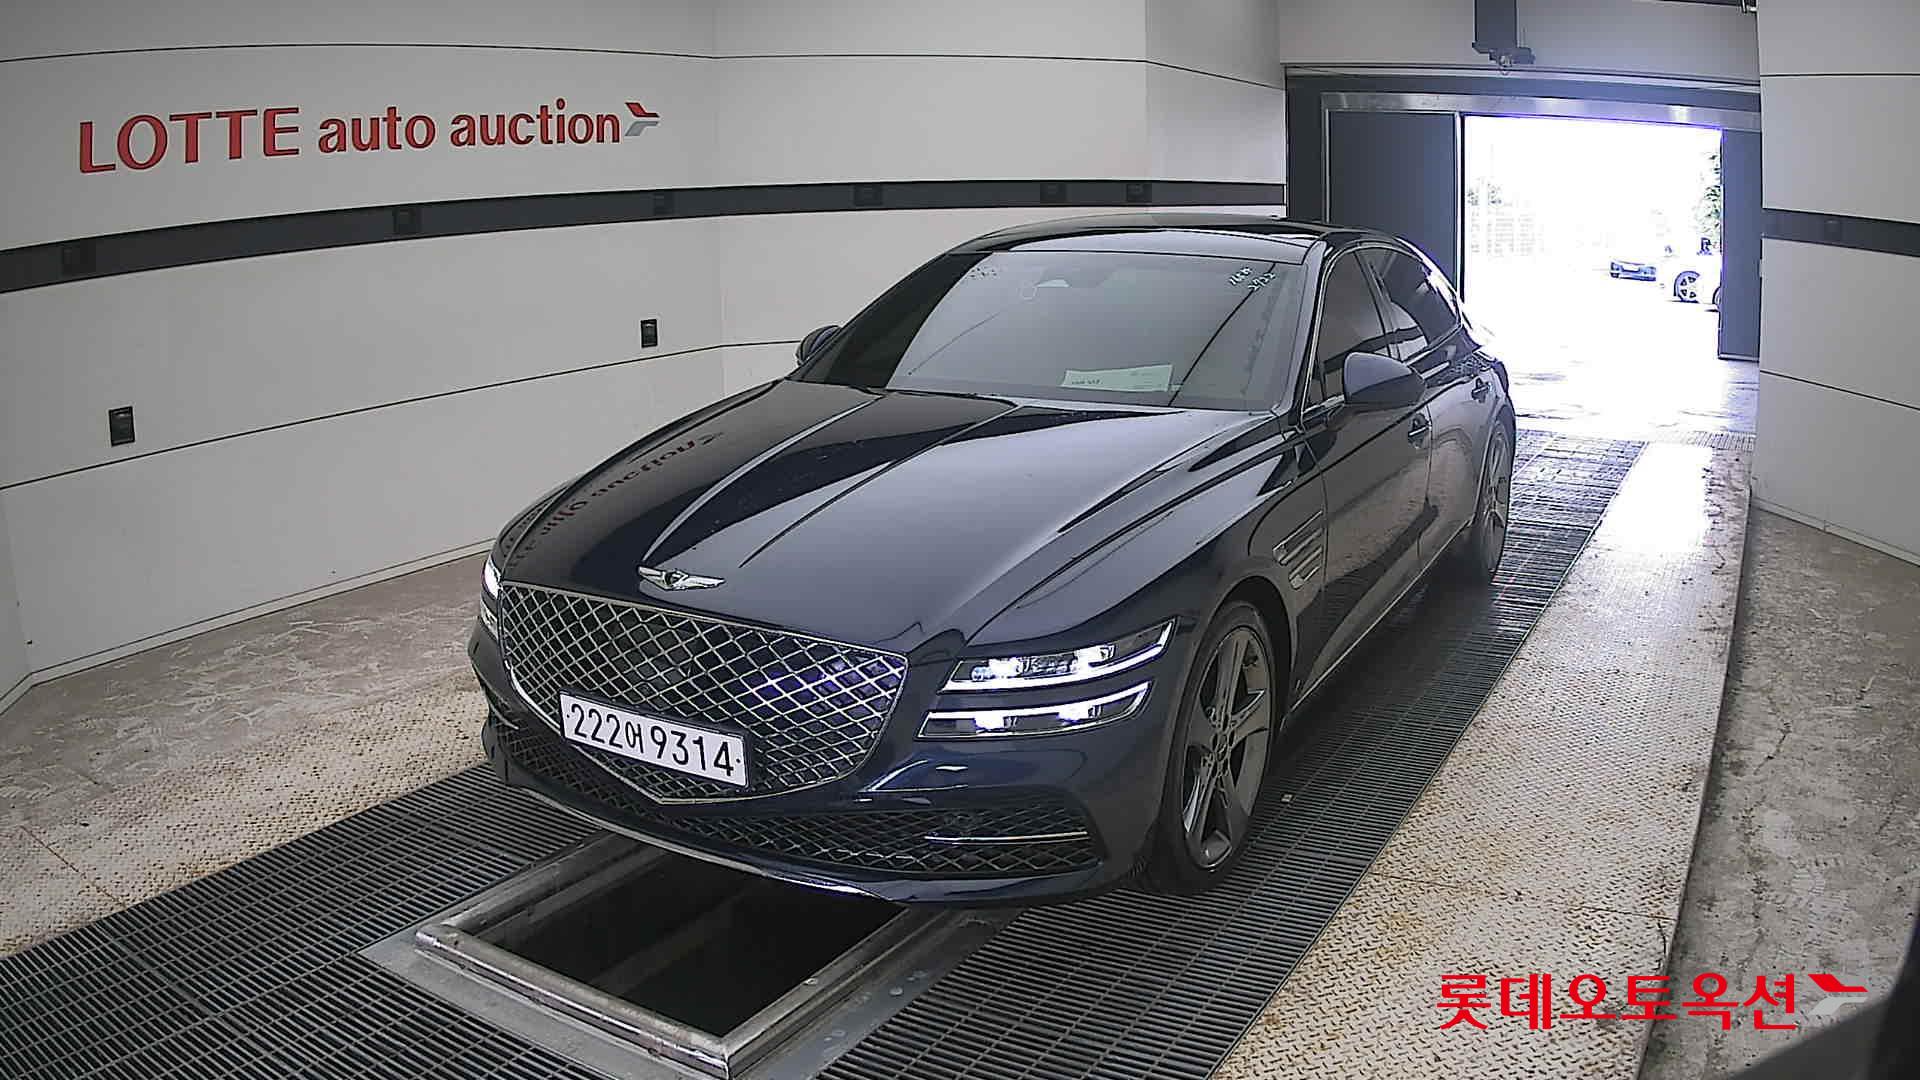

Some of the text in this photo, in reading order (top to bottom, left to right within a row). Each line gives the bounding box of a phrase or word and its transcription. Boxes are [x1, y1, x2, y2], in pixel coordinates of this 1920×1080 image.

[79, 98, 621, 174] LOTTE auto auction
